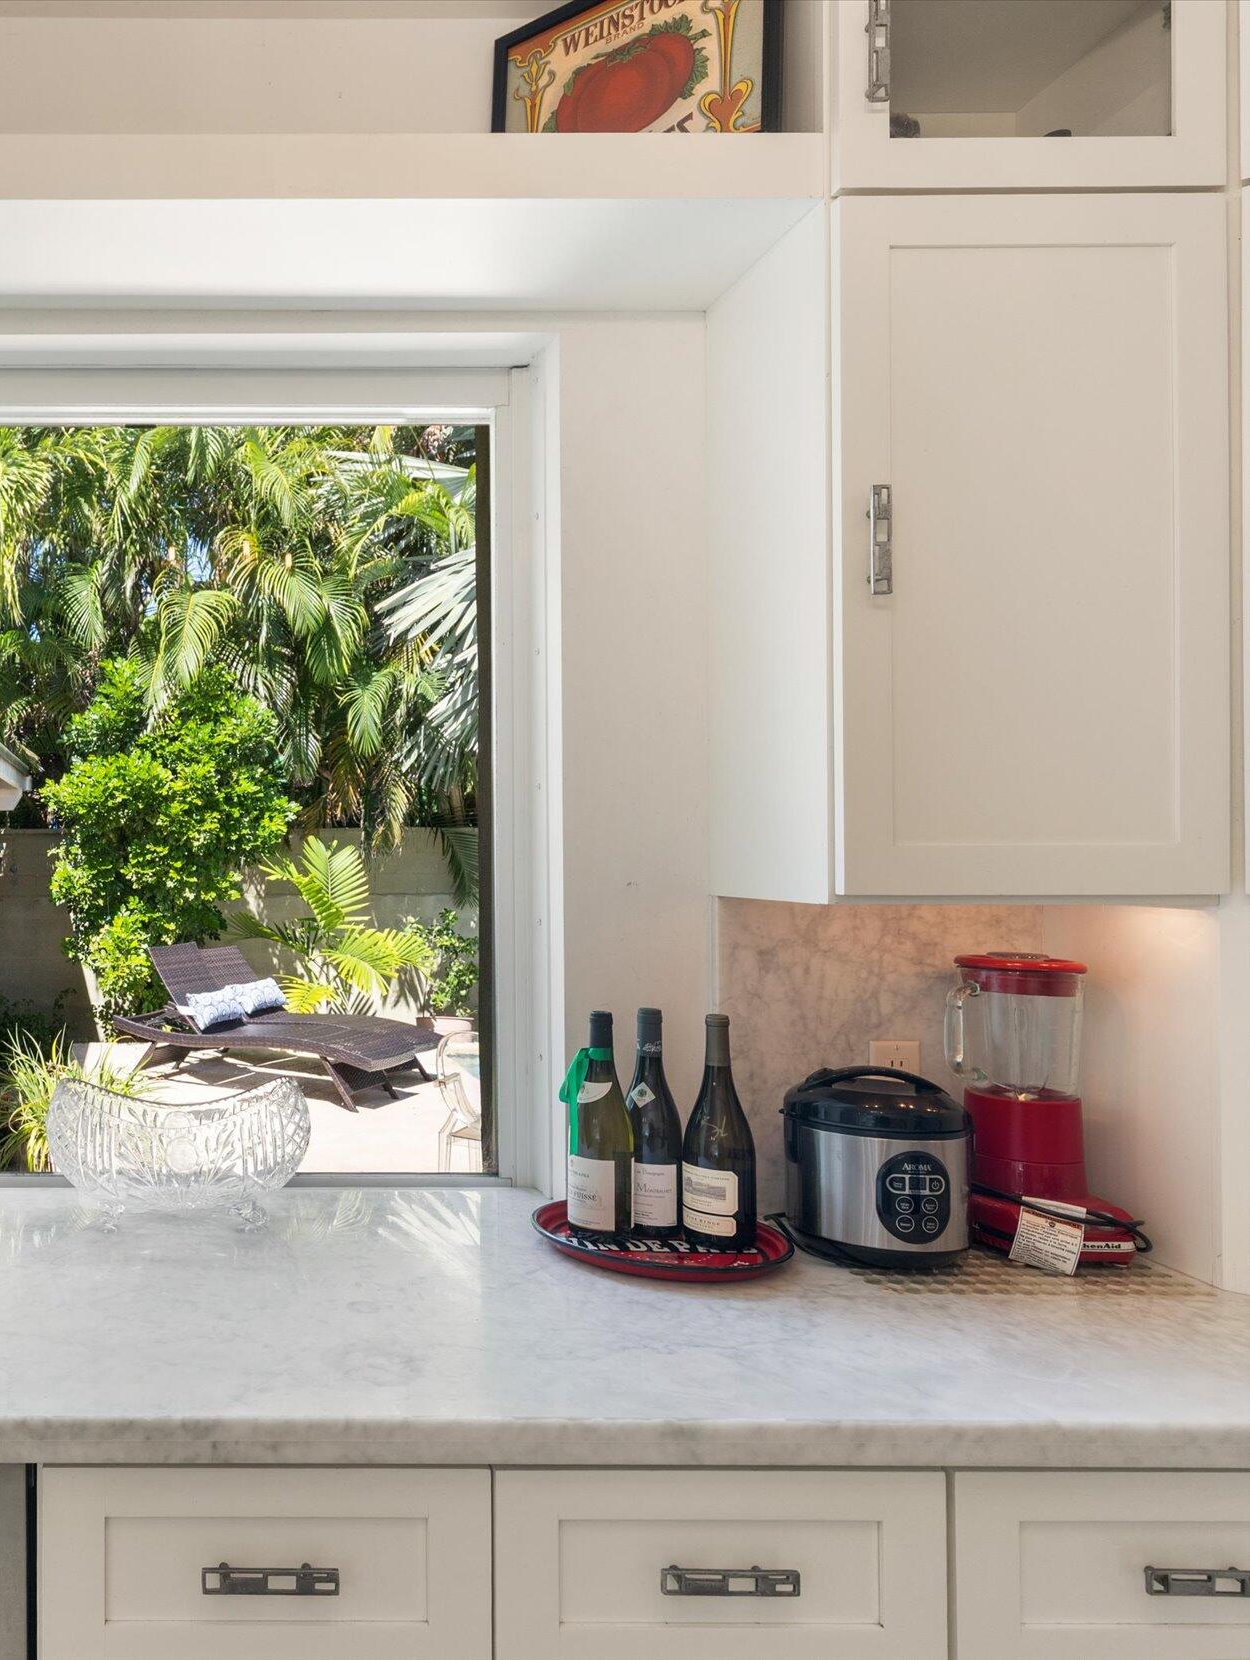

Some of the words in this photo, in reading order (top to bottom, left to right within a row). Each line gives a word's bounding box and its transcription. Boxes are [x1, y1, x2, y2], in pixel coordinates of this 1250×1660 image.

[562, 0, 685, 56] WEINSTO
[605, 21, 644, 45] BRAND
[902, 1162, 931, 1171] AROMA
[1083, 1241, 1122, 1250] henAid
